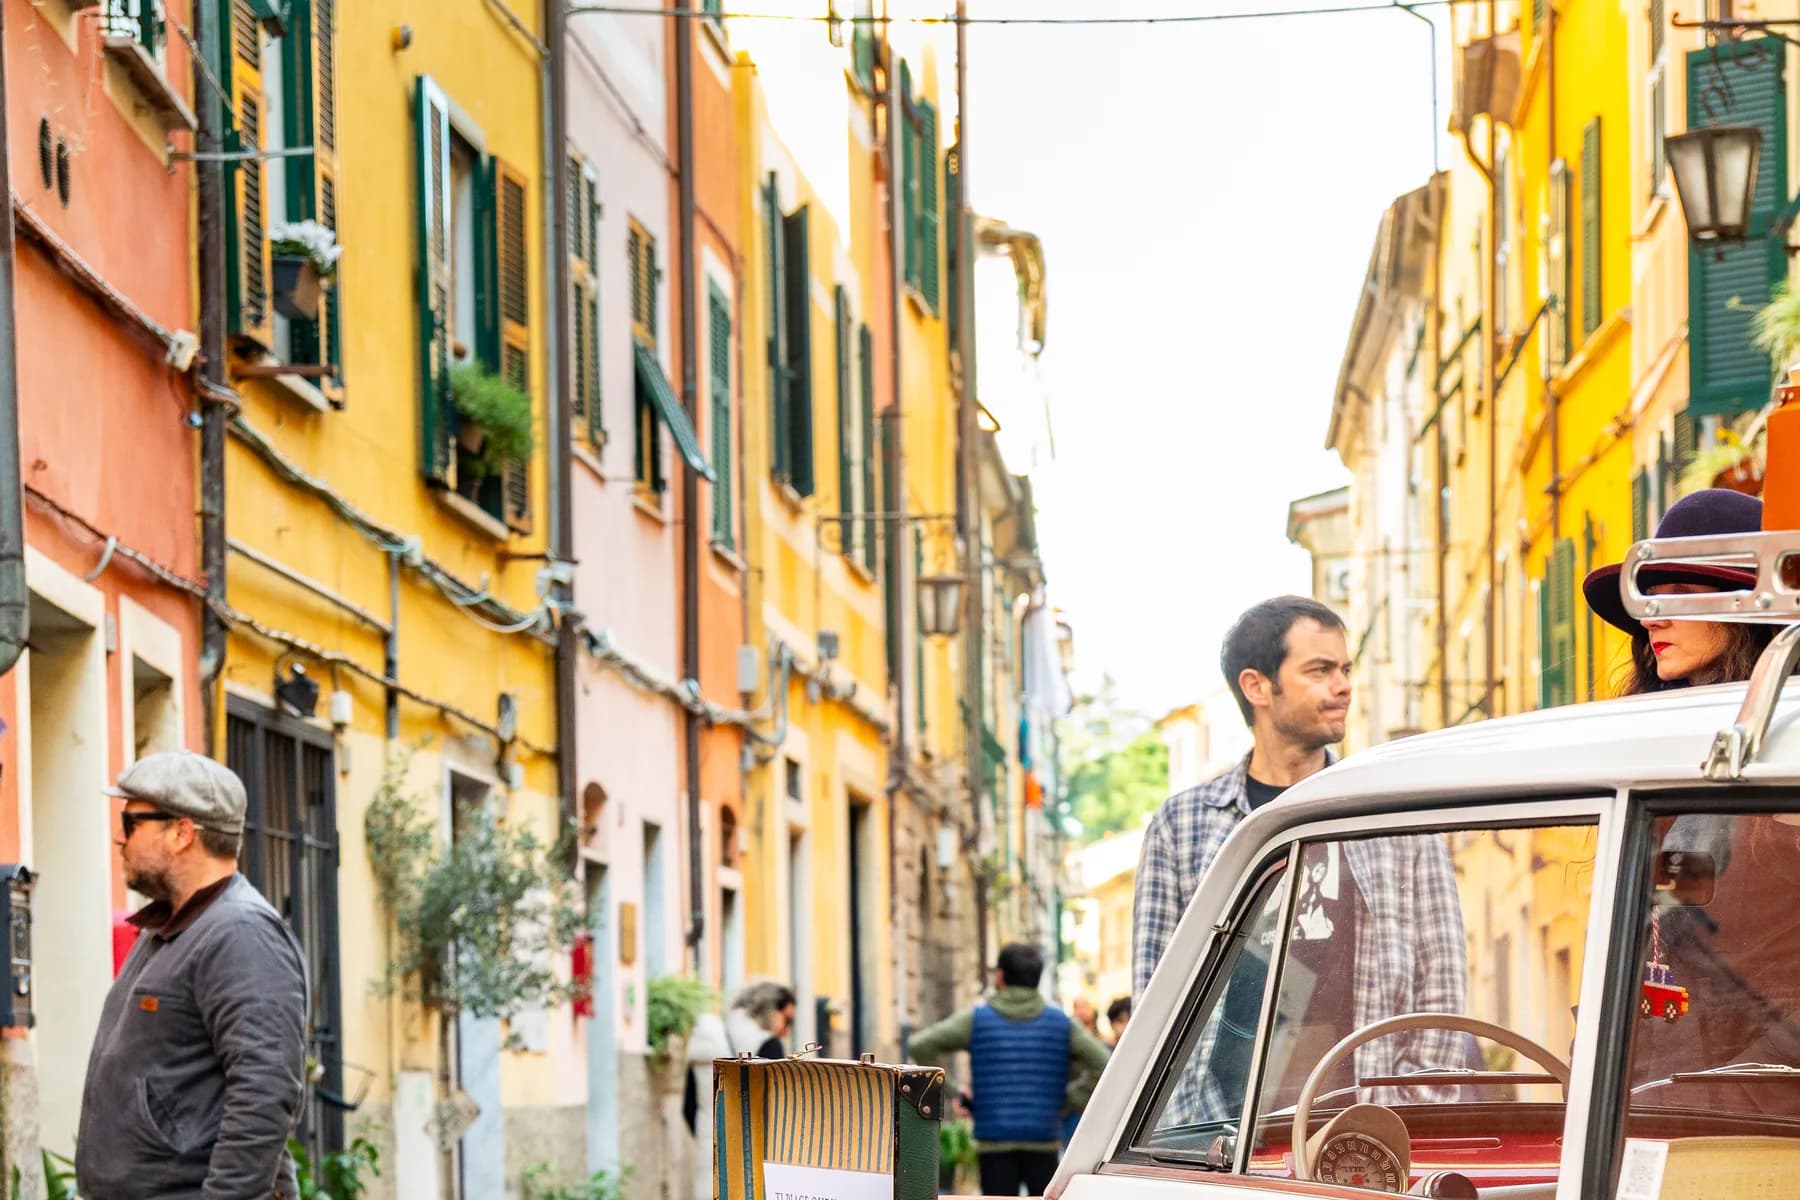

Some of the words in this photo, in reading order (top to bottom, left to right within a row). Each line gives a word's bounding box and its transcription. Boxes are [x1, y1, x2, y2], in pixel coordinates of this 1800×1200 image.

[1334, 1143, 1345, 1154] 50
[1346, 1141, 1357, 1151] 60
[1360, 1142, 1369, 1154] 70
[1371, 1149, 1381, 1161] 80
[1380, 1158, 1391, 1171] 90
[1385, 1172, 1397, 1183] 100
